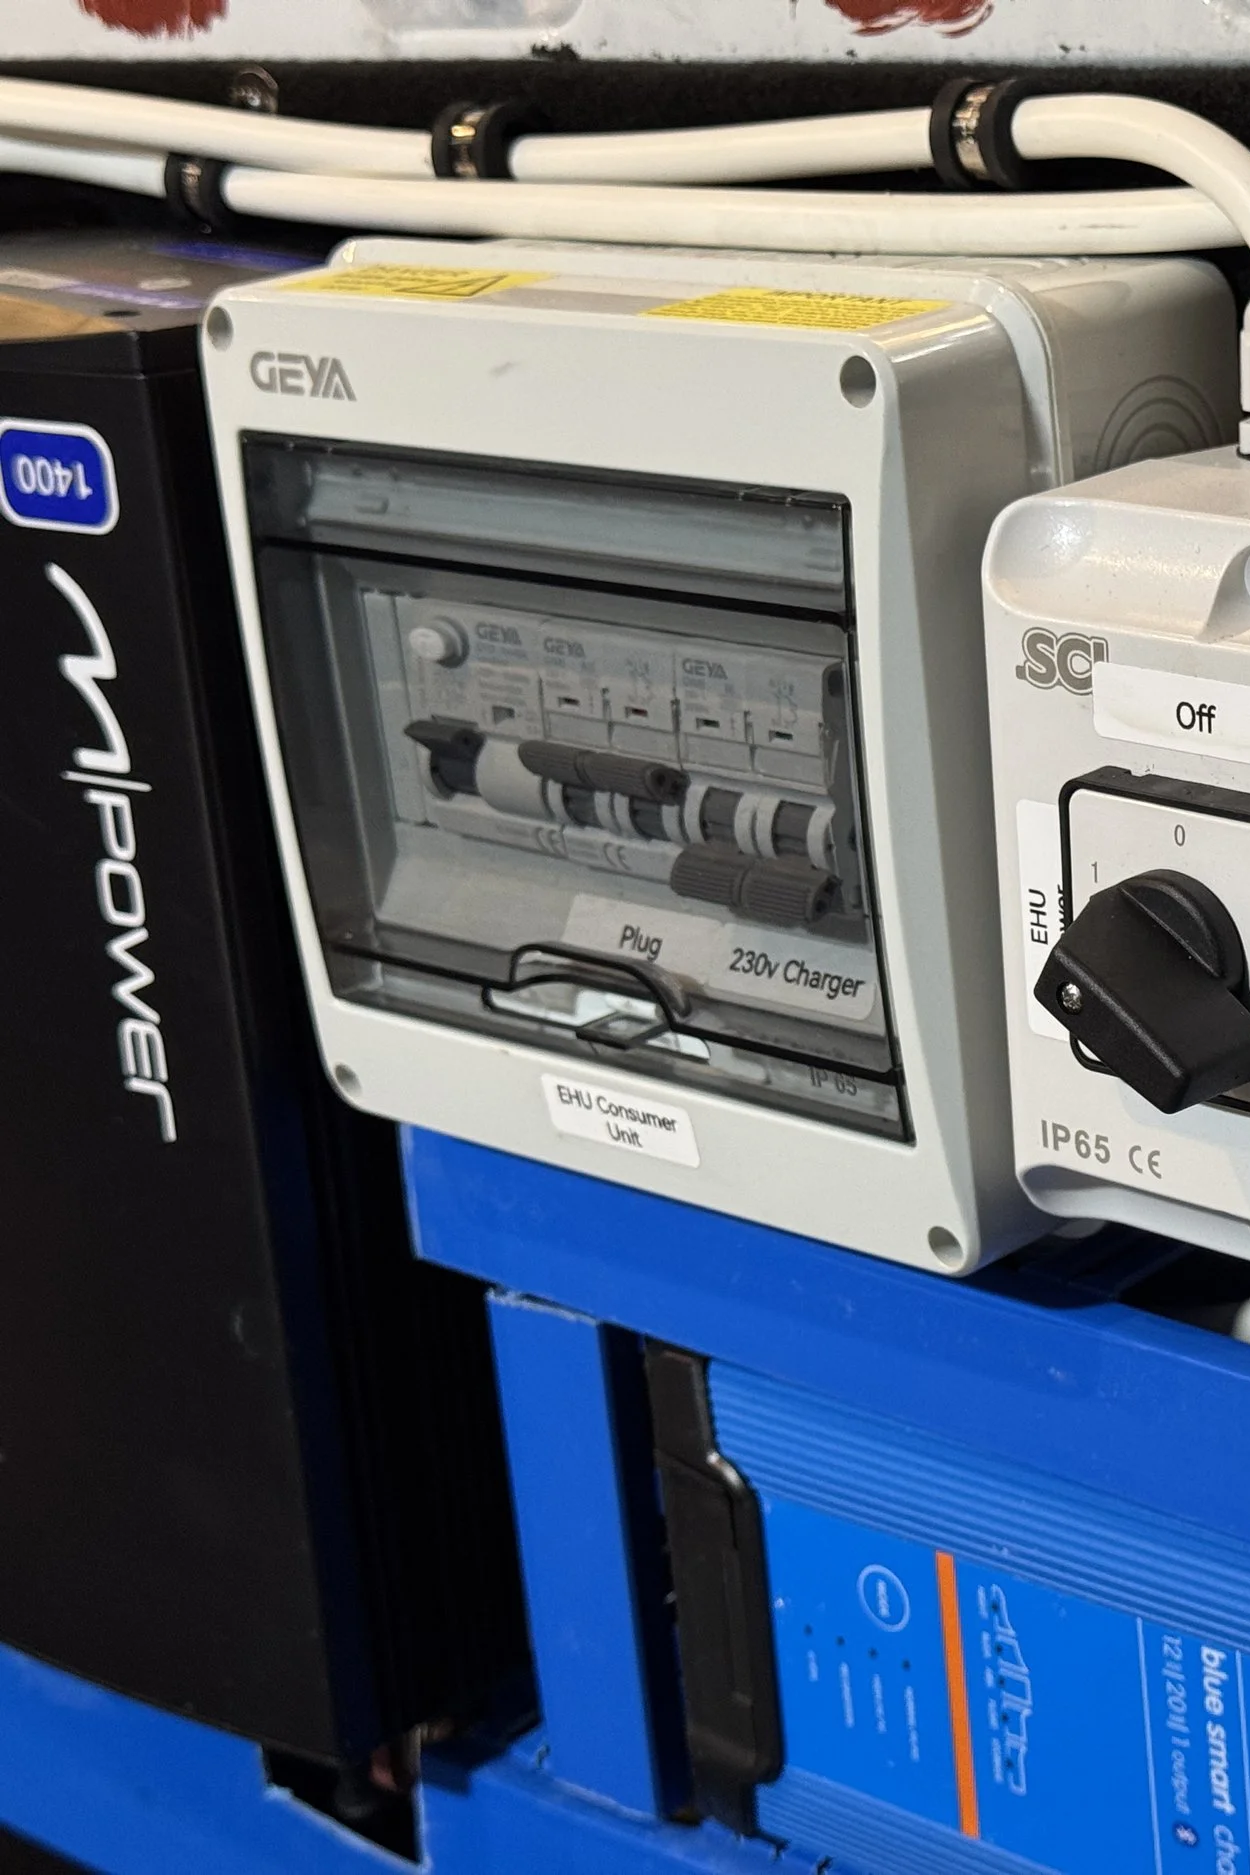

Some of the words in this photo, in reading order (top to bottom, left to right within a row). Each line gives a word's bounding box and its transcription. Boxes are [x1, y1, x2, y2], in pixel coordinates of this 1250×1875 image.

[250, 351, 358, 402] GEYA
[11, 453, 93, 500] 1400
[682, 658, 729, 680] GEYA
[1176, 701, 1217, 734] Off
[1174, 824, 1186, 847] 0
[1028, 888, 1049, 945] EHU
[619, 924, 664, 960] Plug
[729, 948, 781, 979] 230v
[783, 959, 866, 1000] Charger
[556, 1084, 593, 1110] EHU
[596, 1095, 677, 1132] Consumer
[607, 1120, 644, 1148] Unit
[1041, 1119, 1111, 1164] IP65
[1201, 1645, 1229, 1716] blue
[1206, 1720, 1236, 1816] smart
